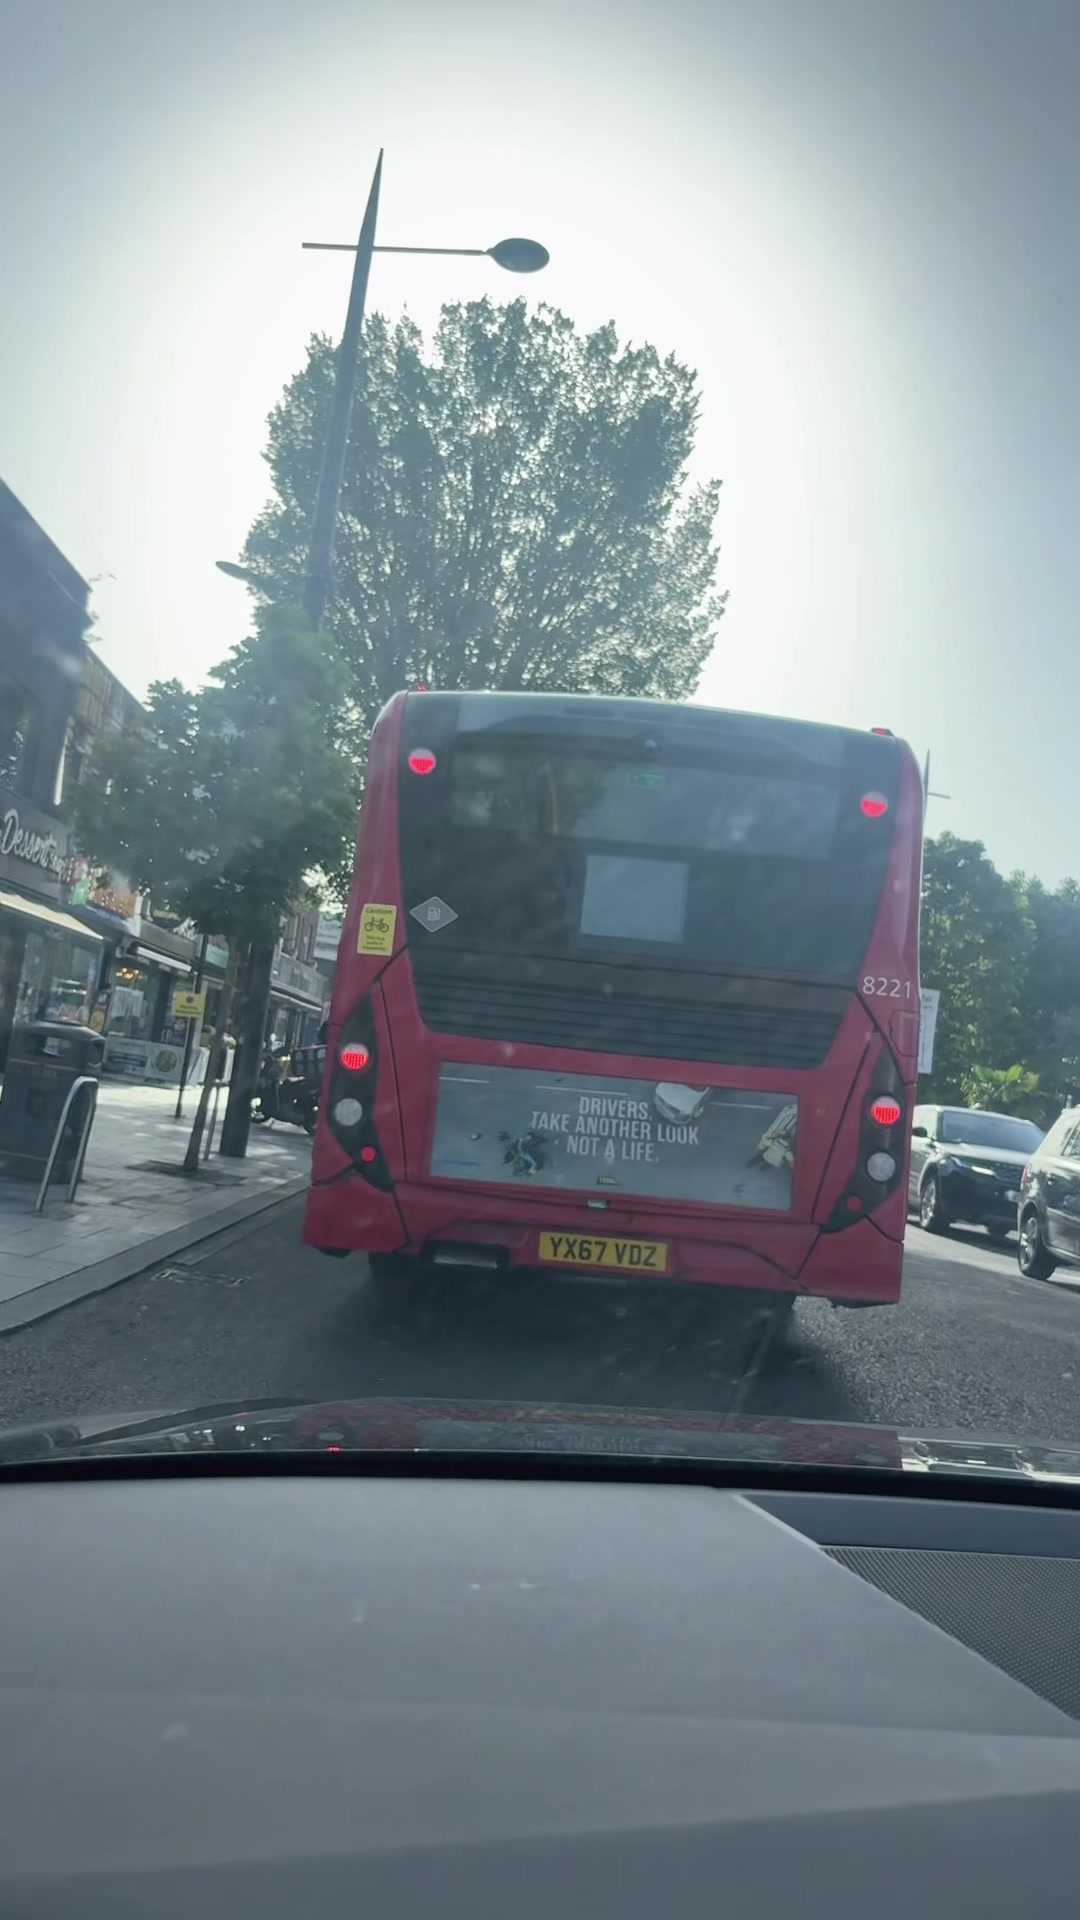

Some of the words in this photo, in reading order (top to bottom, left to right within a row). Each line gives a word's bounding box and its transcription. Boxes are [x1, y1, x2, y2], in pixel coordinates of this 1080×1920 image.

[1, 809, 57, 868] Dessert
[365, 906, 393, 915] Caution
[862, 976, 911, 999] 8221
[531, 1111, 571, 1133] TAKE
[575, 1116, 651, 1141] ANOTHER
[657, 1123, 699, 1145] LOOK
[566, 1135, 600, 1157] NOT
[604, 1139, 615, 1159] A
[621, 1141, 660, 1163] LIFE.
[550, 1236, 608, 1262] YX67
[615, 1243, 658, 1267] VDZ
